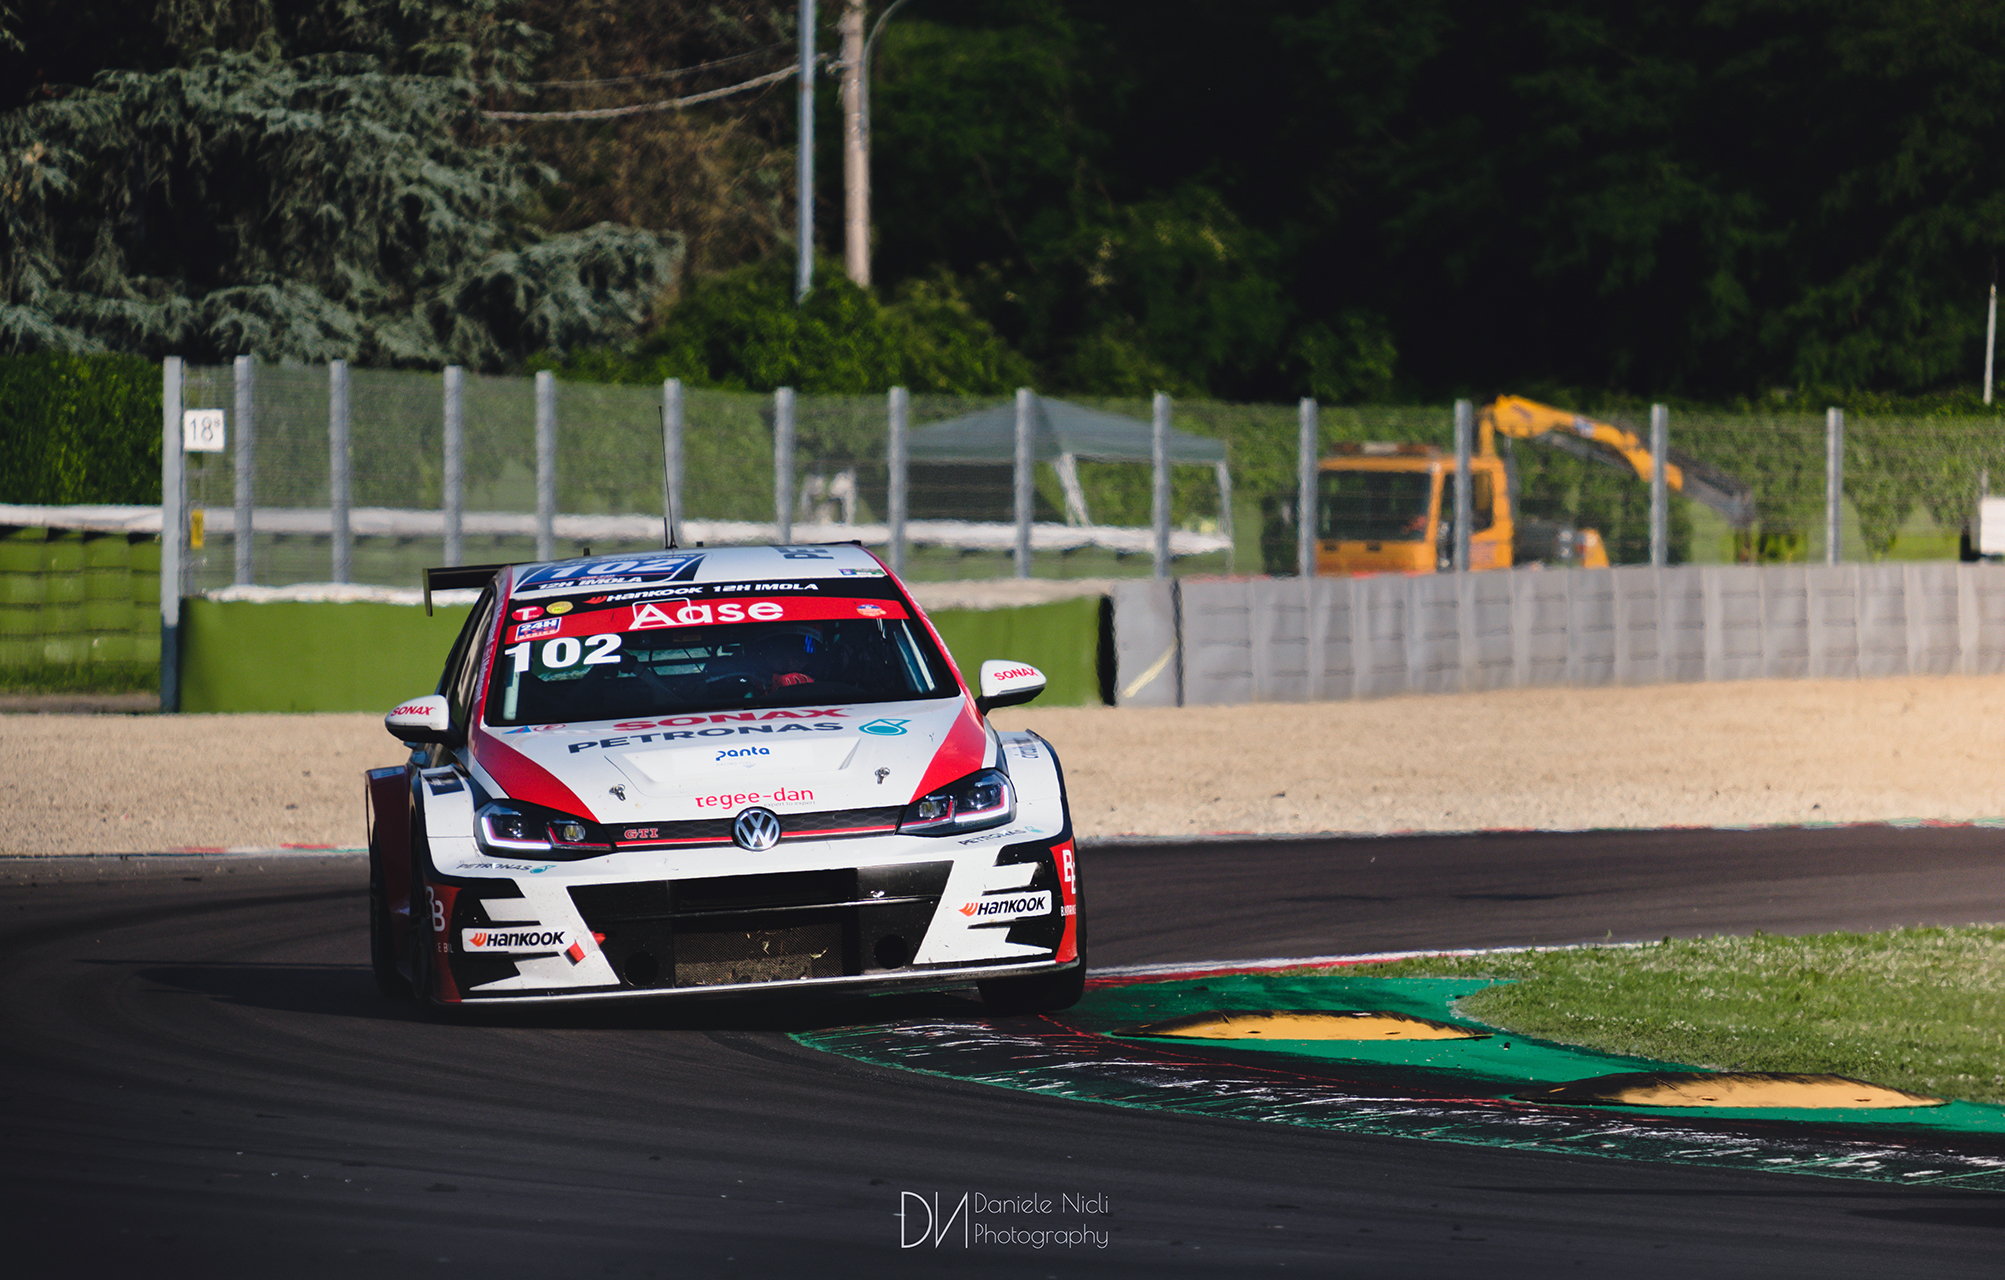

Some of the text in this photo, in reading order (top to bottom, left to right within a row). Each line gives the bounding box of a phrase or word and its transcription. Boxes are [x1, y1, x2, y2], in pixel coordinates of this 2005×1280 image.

[549, 558, 687, 579] 102
[538, 578, 574, 590] 12H
[578, 576, 643, 587] IMOLA
[713, 583, 751, 592] 12H
[754, 583, 819, 591] IMOLA
[628, 601, 784, 631] Aase
[520, 619, 557, 633] 24H
[504, 633, 622, 673] 102
[994, 668, 1039, 681] SONAX
[390, 706, 433, 717] SONAX
[613, 708, 851, 731] SONAX
[567, 722, 844, 754] PETRONAS
[715, 746, 770, 761] panta
[624, 828, 658, 838] GTI
[958, 829, 1026, 845] PETRONAS
[456, 863, 532, 871] PETRONAS
